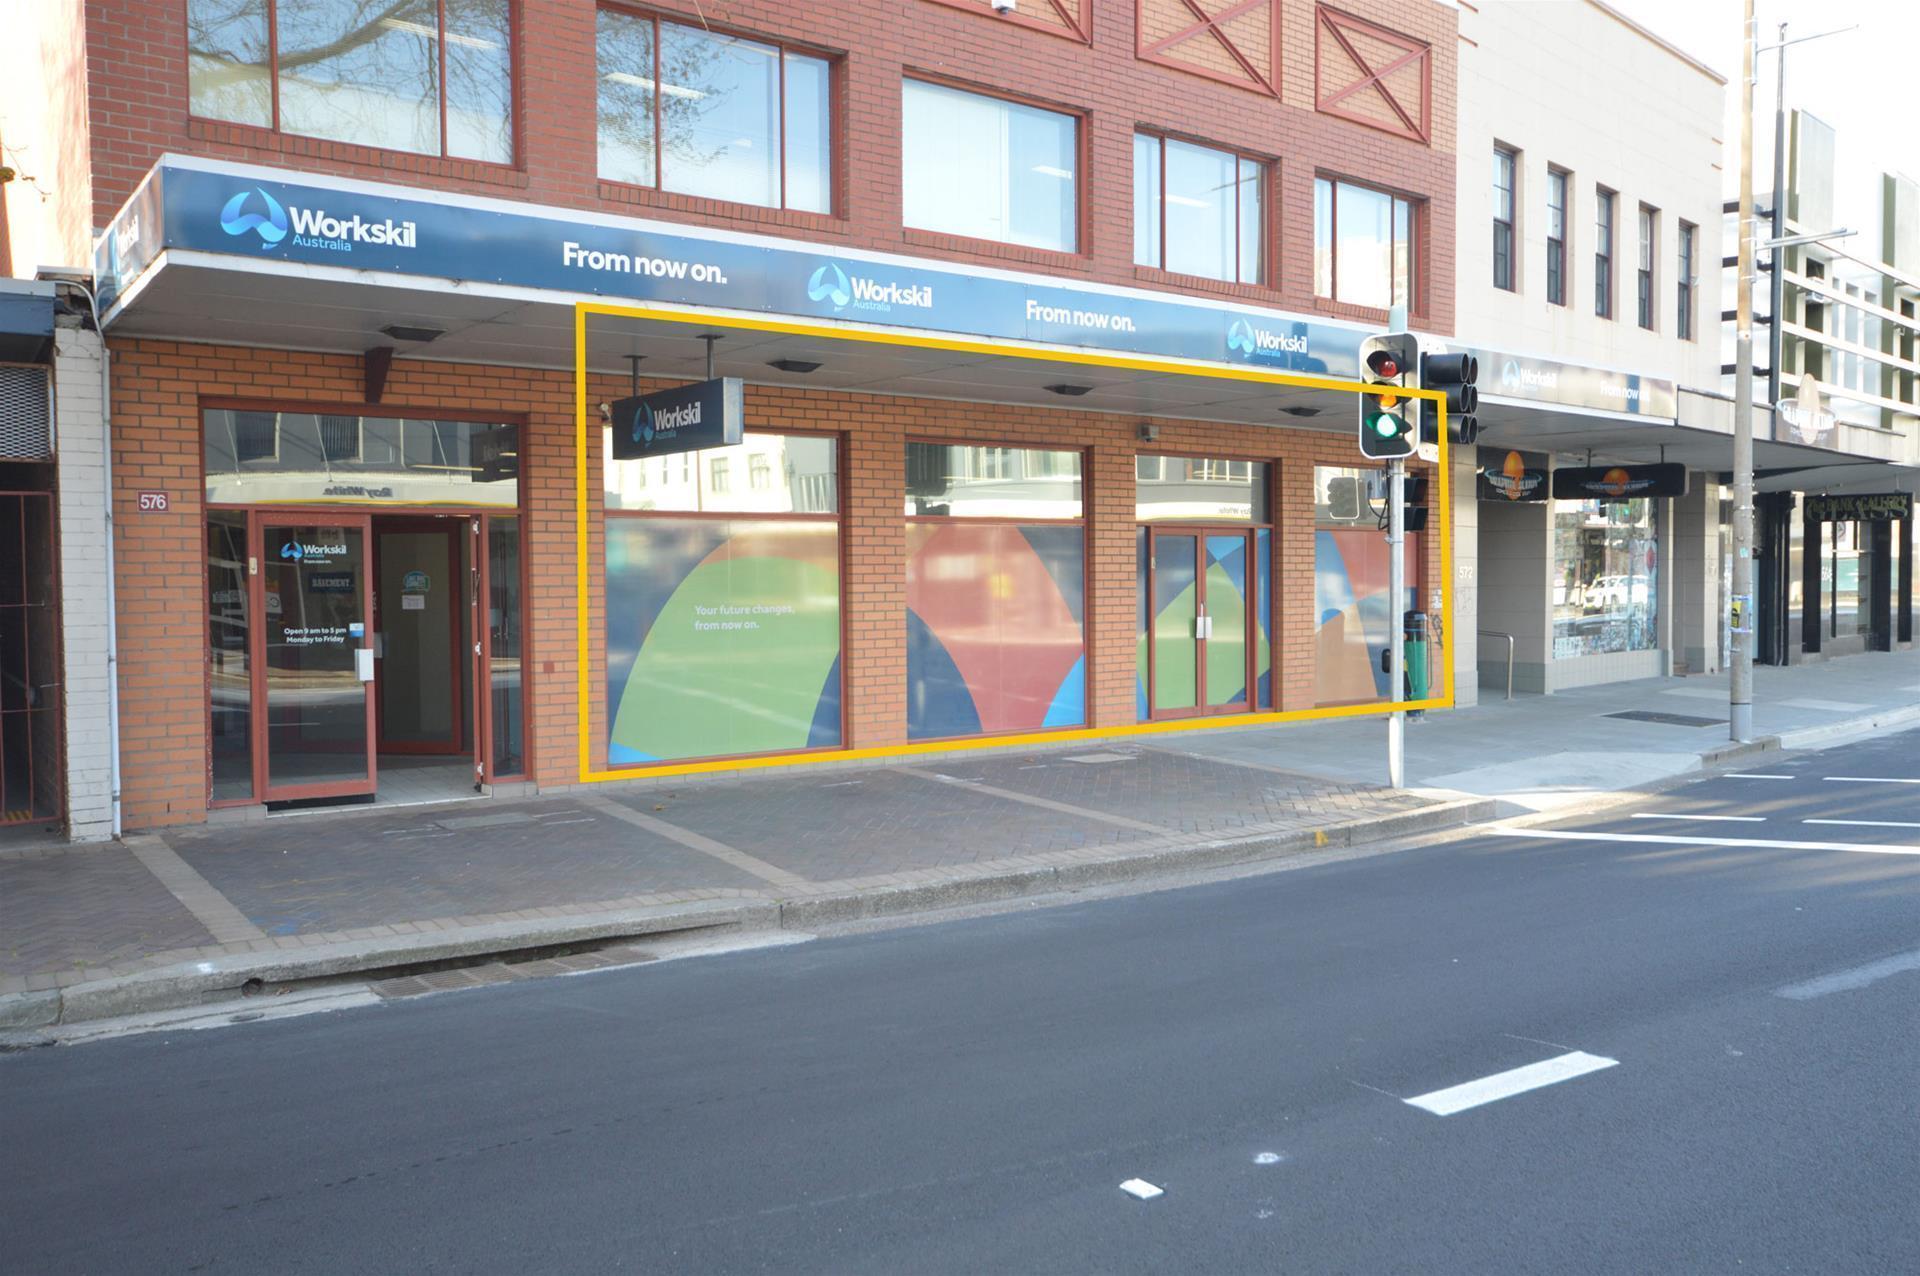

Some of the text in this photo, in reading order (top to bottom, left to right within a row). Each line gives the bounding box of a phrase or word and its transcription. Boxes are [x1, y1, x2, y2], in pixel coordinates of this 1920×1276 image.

[289, 206, 417, 248] Workskil
[292, 234, 352, 252] Australia
[563, 241, 728, 285] From now on.
[851, 277, 933, 308] Workskil
[853, 299, 891, 312] Australia
[1026, 299, 1136, 332] From now on.
[1254, 328, 1308, 353] Workskil
[1600, 380, 1621, 398] From
[1622, 388, 1639, 400] now
[654, 401, 702, 431] Workskil
[140, 494, 167, 510] 576
[303, 544, 347, 554] Workskil
[695, 603, 718, 615] Your
[720, 605, 751, 615] future
[284, 627, 303, 635] Open
[335, 627, 347, 635] pm
[695, 621, 760, 630] from now on.
[323, 635, 345, 643] Friday
